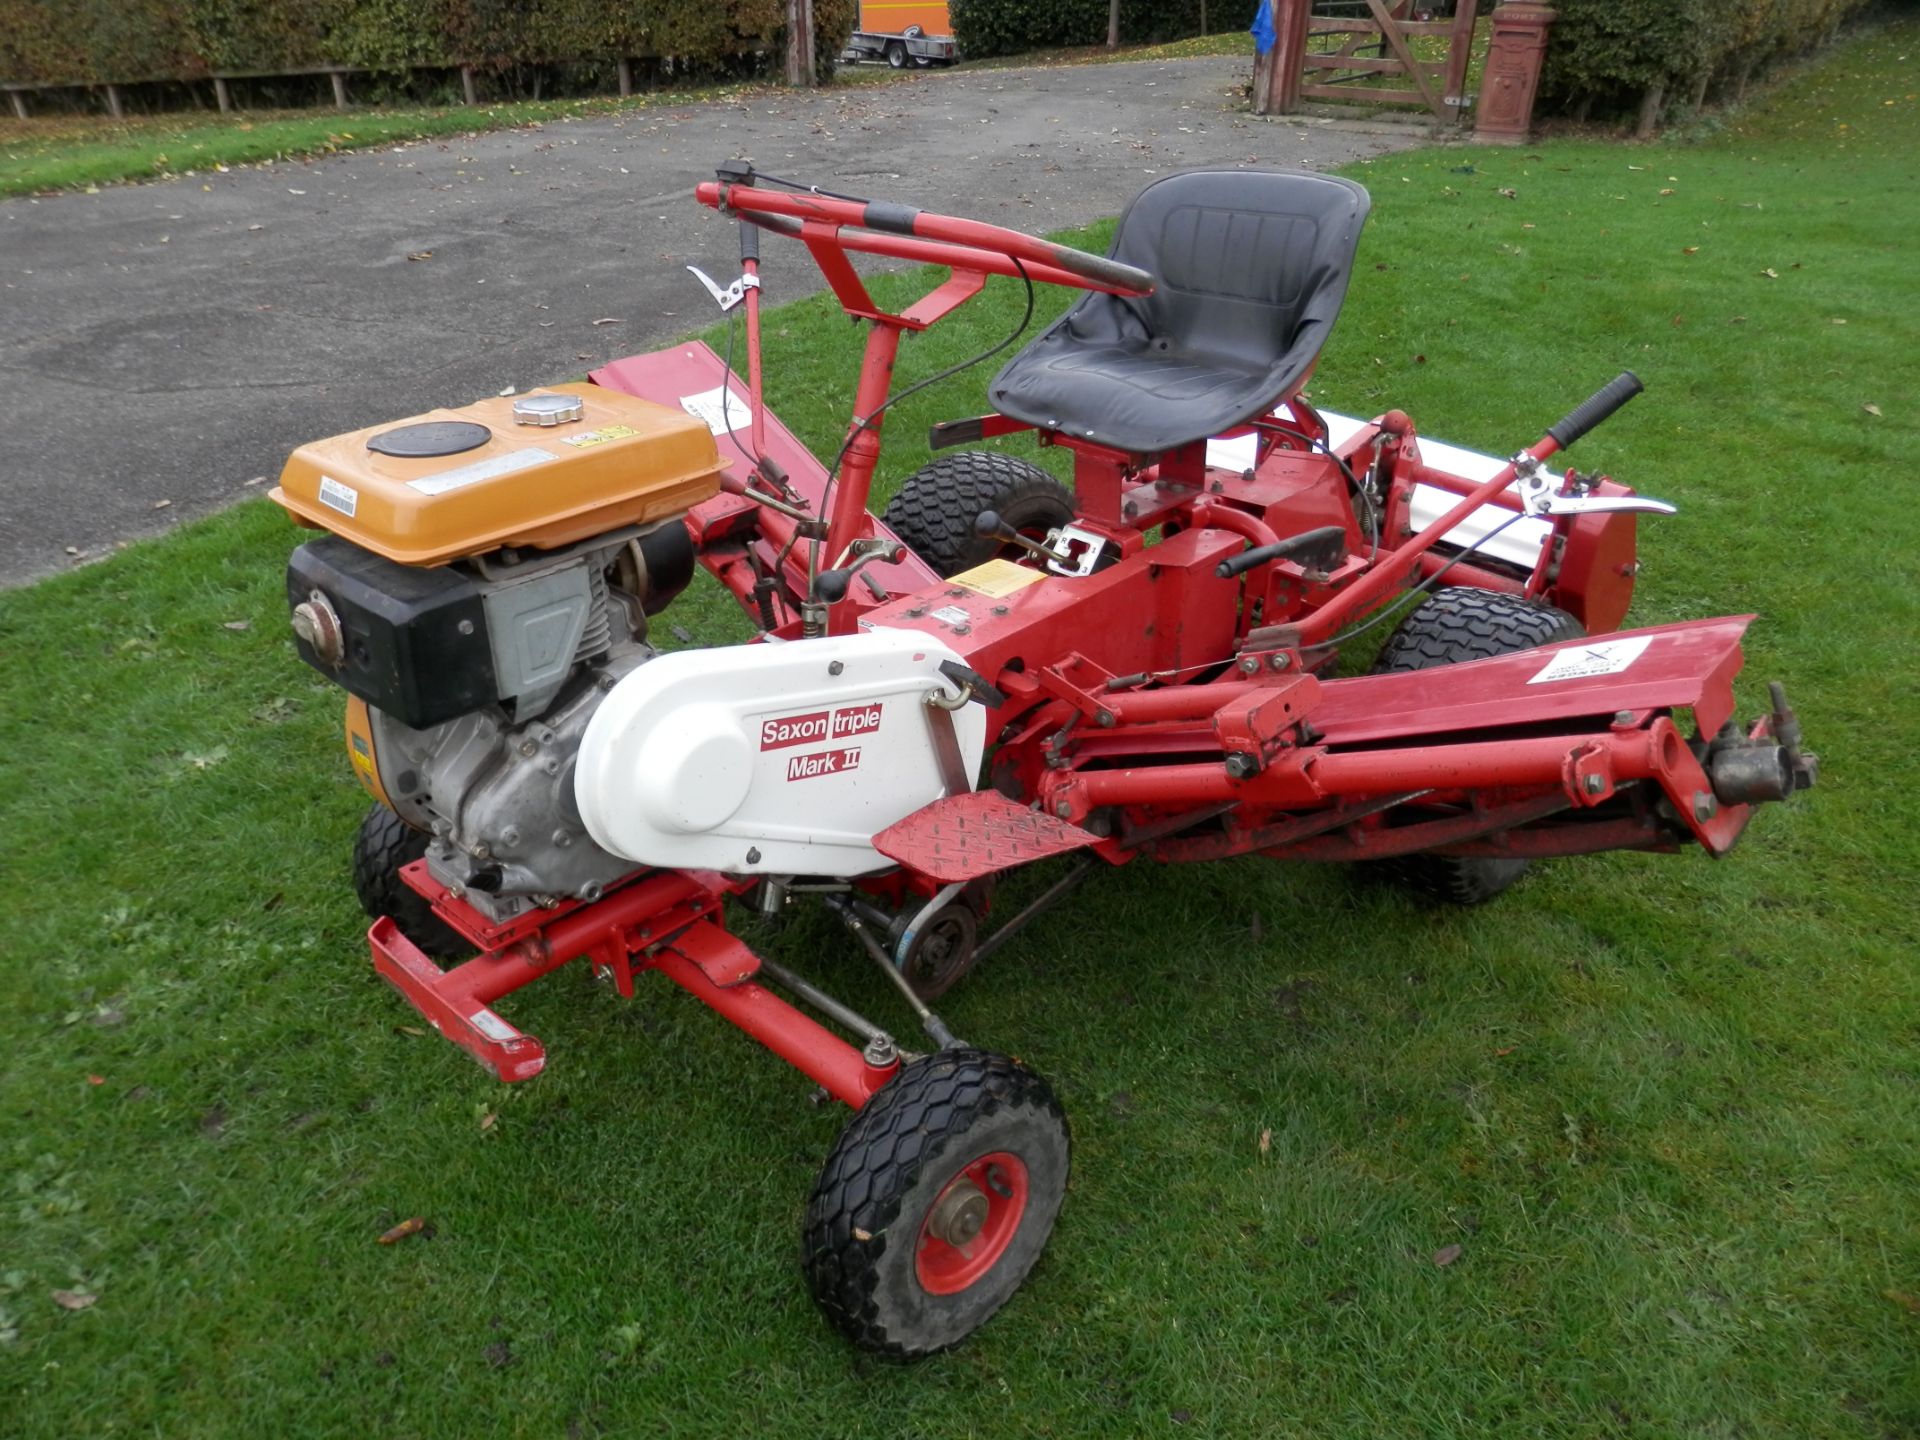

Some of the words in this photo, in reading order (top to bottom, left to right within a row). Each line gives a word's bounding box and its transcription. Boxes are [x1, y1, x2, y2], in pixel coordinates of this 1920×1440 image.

[762, 718, 827, 744] Saxon
[834, 707, 880, 735] triple
[788, 752, 837, 779] Mark
[841, 748, 861, 769] II
